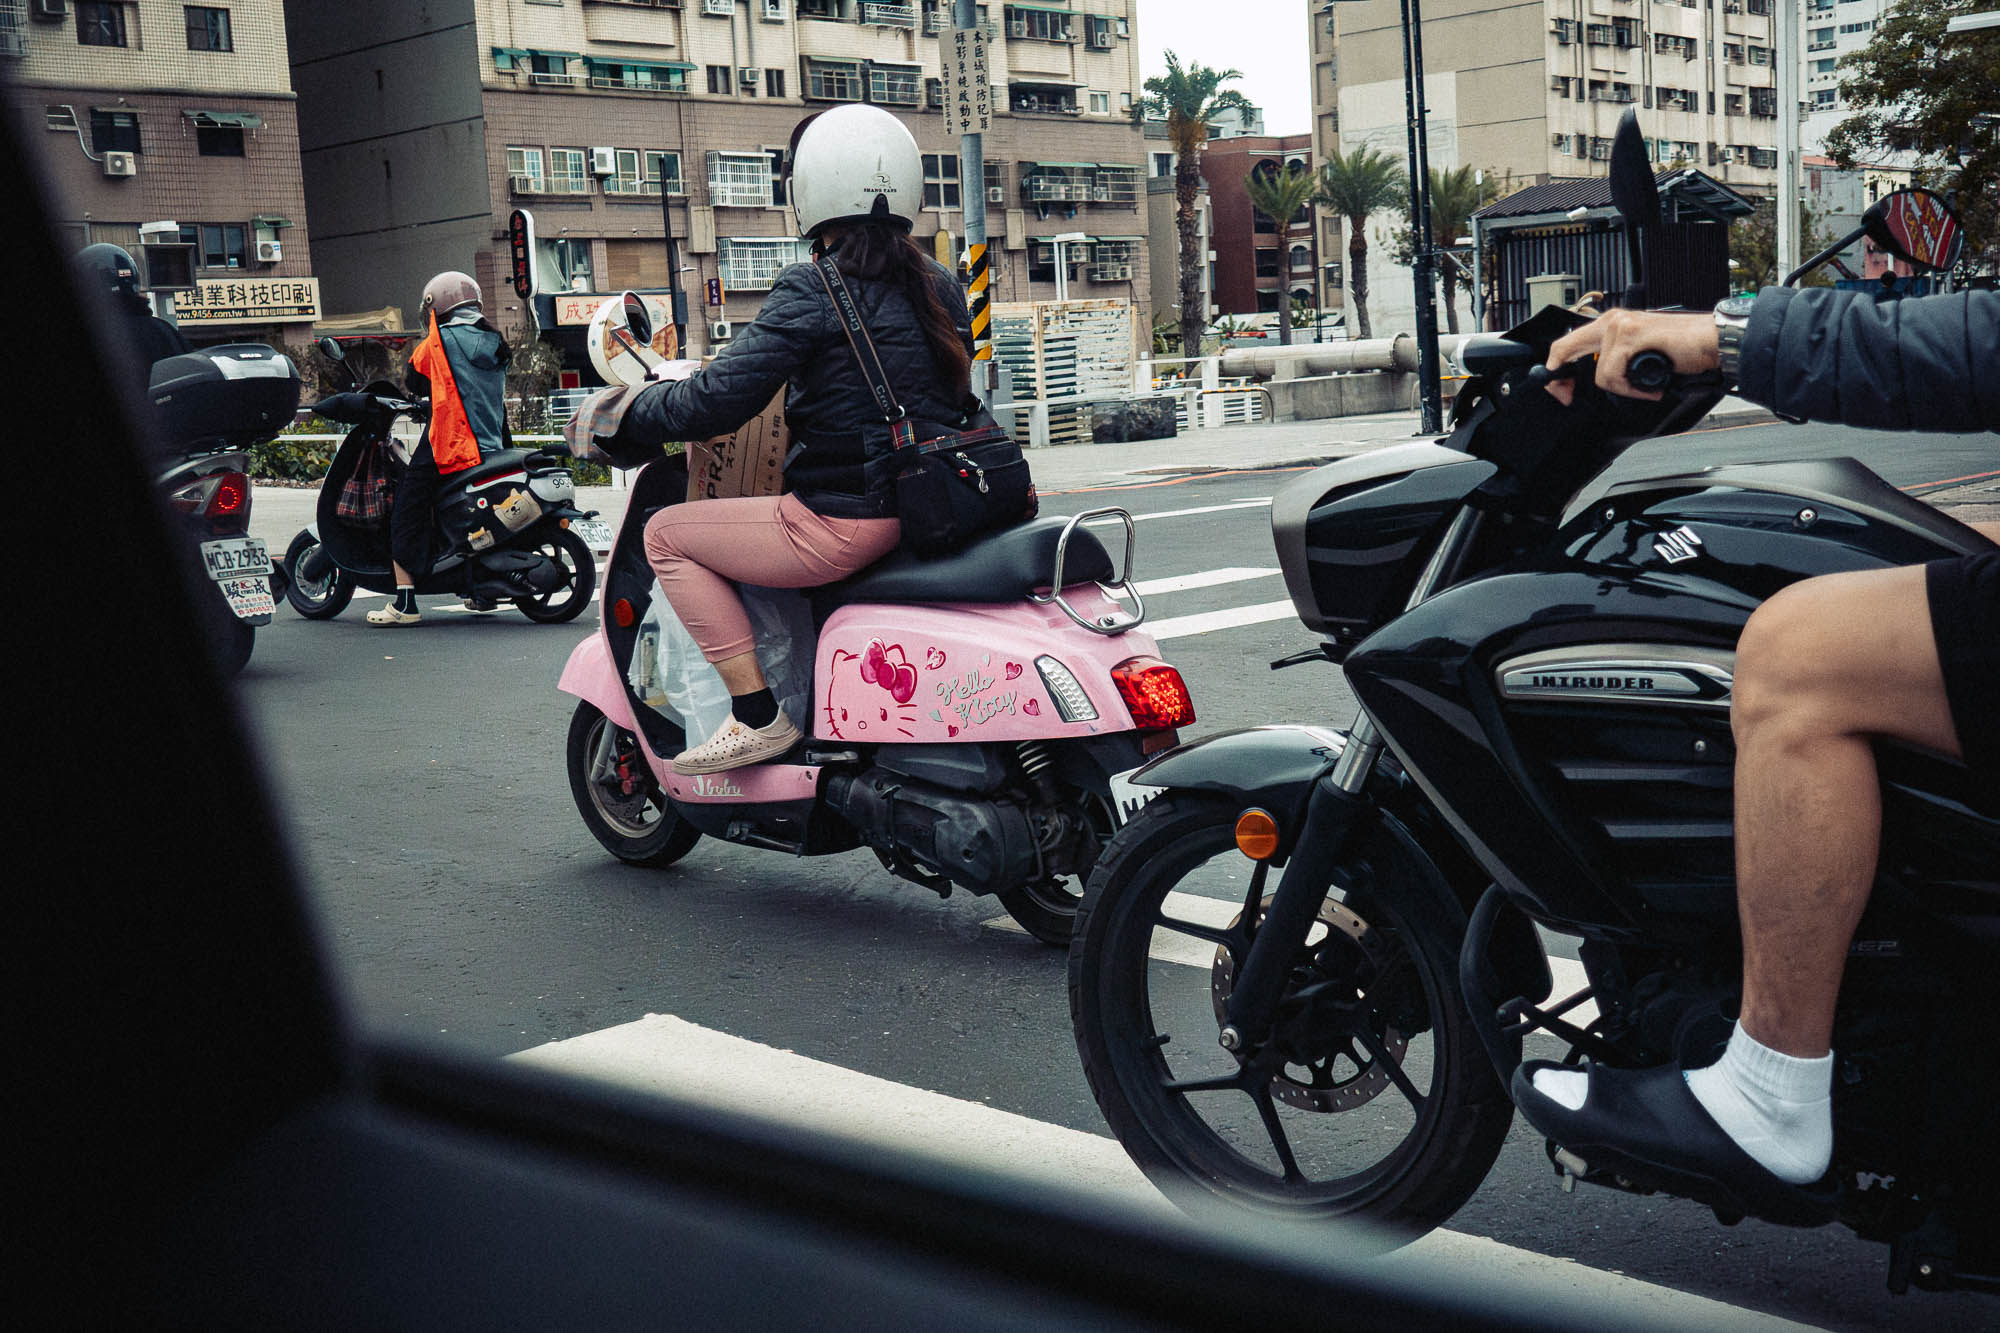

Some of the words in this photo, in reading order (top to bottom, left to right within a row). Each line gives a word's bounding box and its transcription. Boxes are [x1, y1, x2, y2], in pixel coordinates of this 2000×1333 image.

[823, 262, 841, 288] Bear
[839, 291, 861, 332] Crown
[936, 668, 995, 706] Hello
[1533, 676, 1654, 689] INTRUDER
[953, 690, 1017, 729] Kitty
